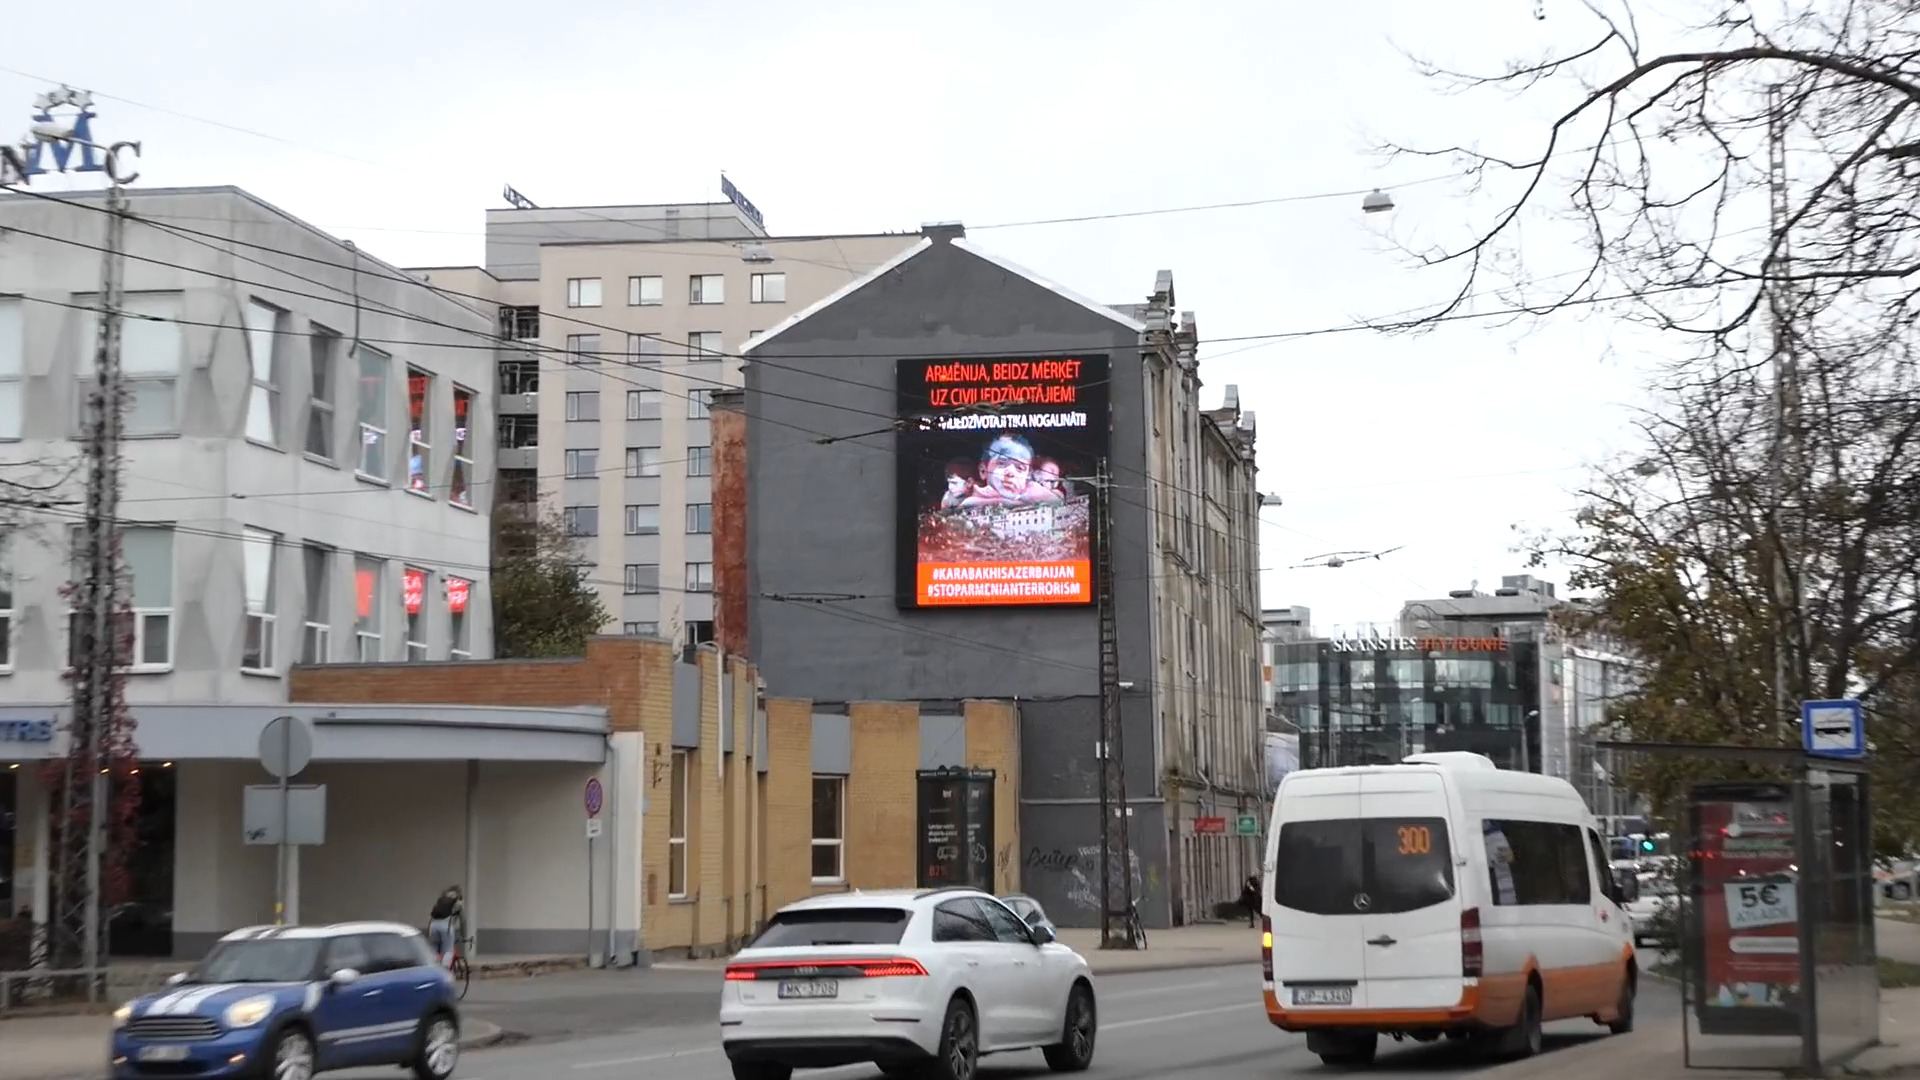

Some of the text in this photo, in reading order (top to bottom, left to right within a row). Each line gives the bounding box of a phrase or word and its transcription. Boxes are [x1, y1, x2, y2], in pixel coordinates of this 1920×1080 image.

[925, 359, 1081, 383] ARMĒNIJA, BEIDZ MĒRĶĒT
[931, 388, 948, 406] UZ
[932, 565, 1075, 581] #KARABAKHISAZERBAIJAN
[927, 582, 1081, 598] #STOPARMENIANTERRORISM
[1333, 636, 1417, 653] SKANSTES
[1397, 825, 1430, 854] 300
[1740, 884, 1780, 908] 5€
